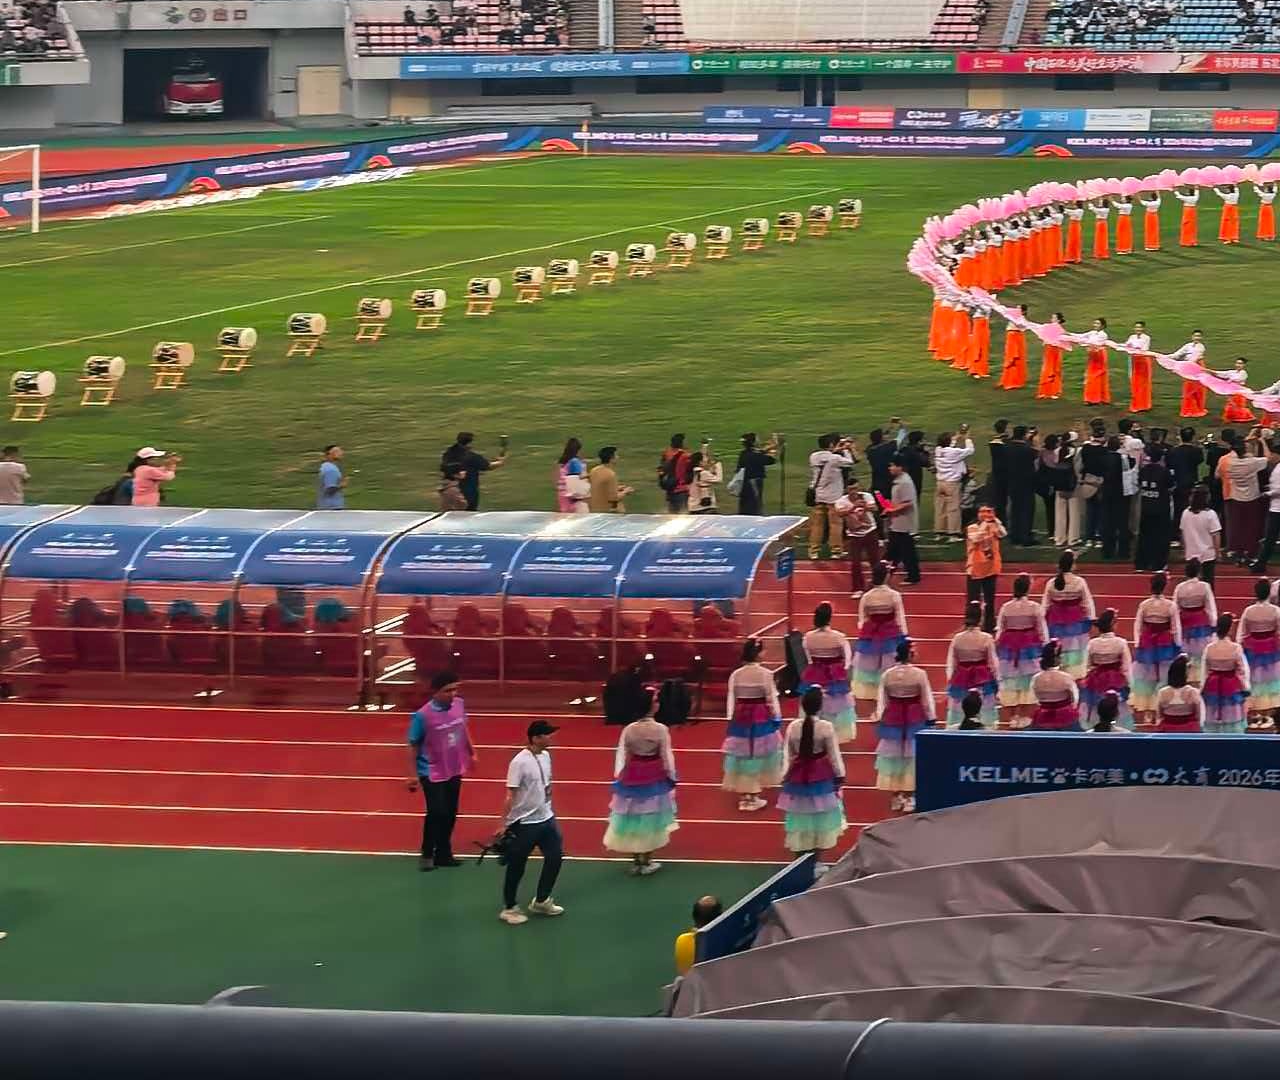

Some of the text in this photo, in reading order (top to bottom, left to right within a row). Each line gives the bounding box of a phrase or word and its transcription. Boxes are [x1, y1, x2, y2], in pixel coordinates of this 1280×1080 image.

[959, 766, 1049, 784] KELME
[1072, 768, 1124, 784] 卡尔美
